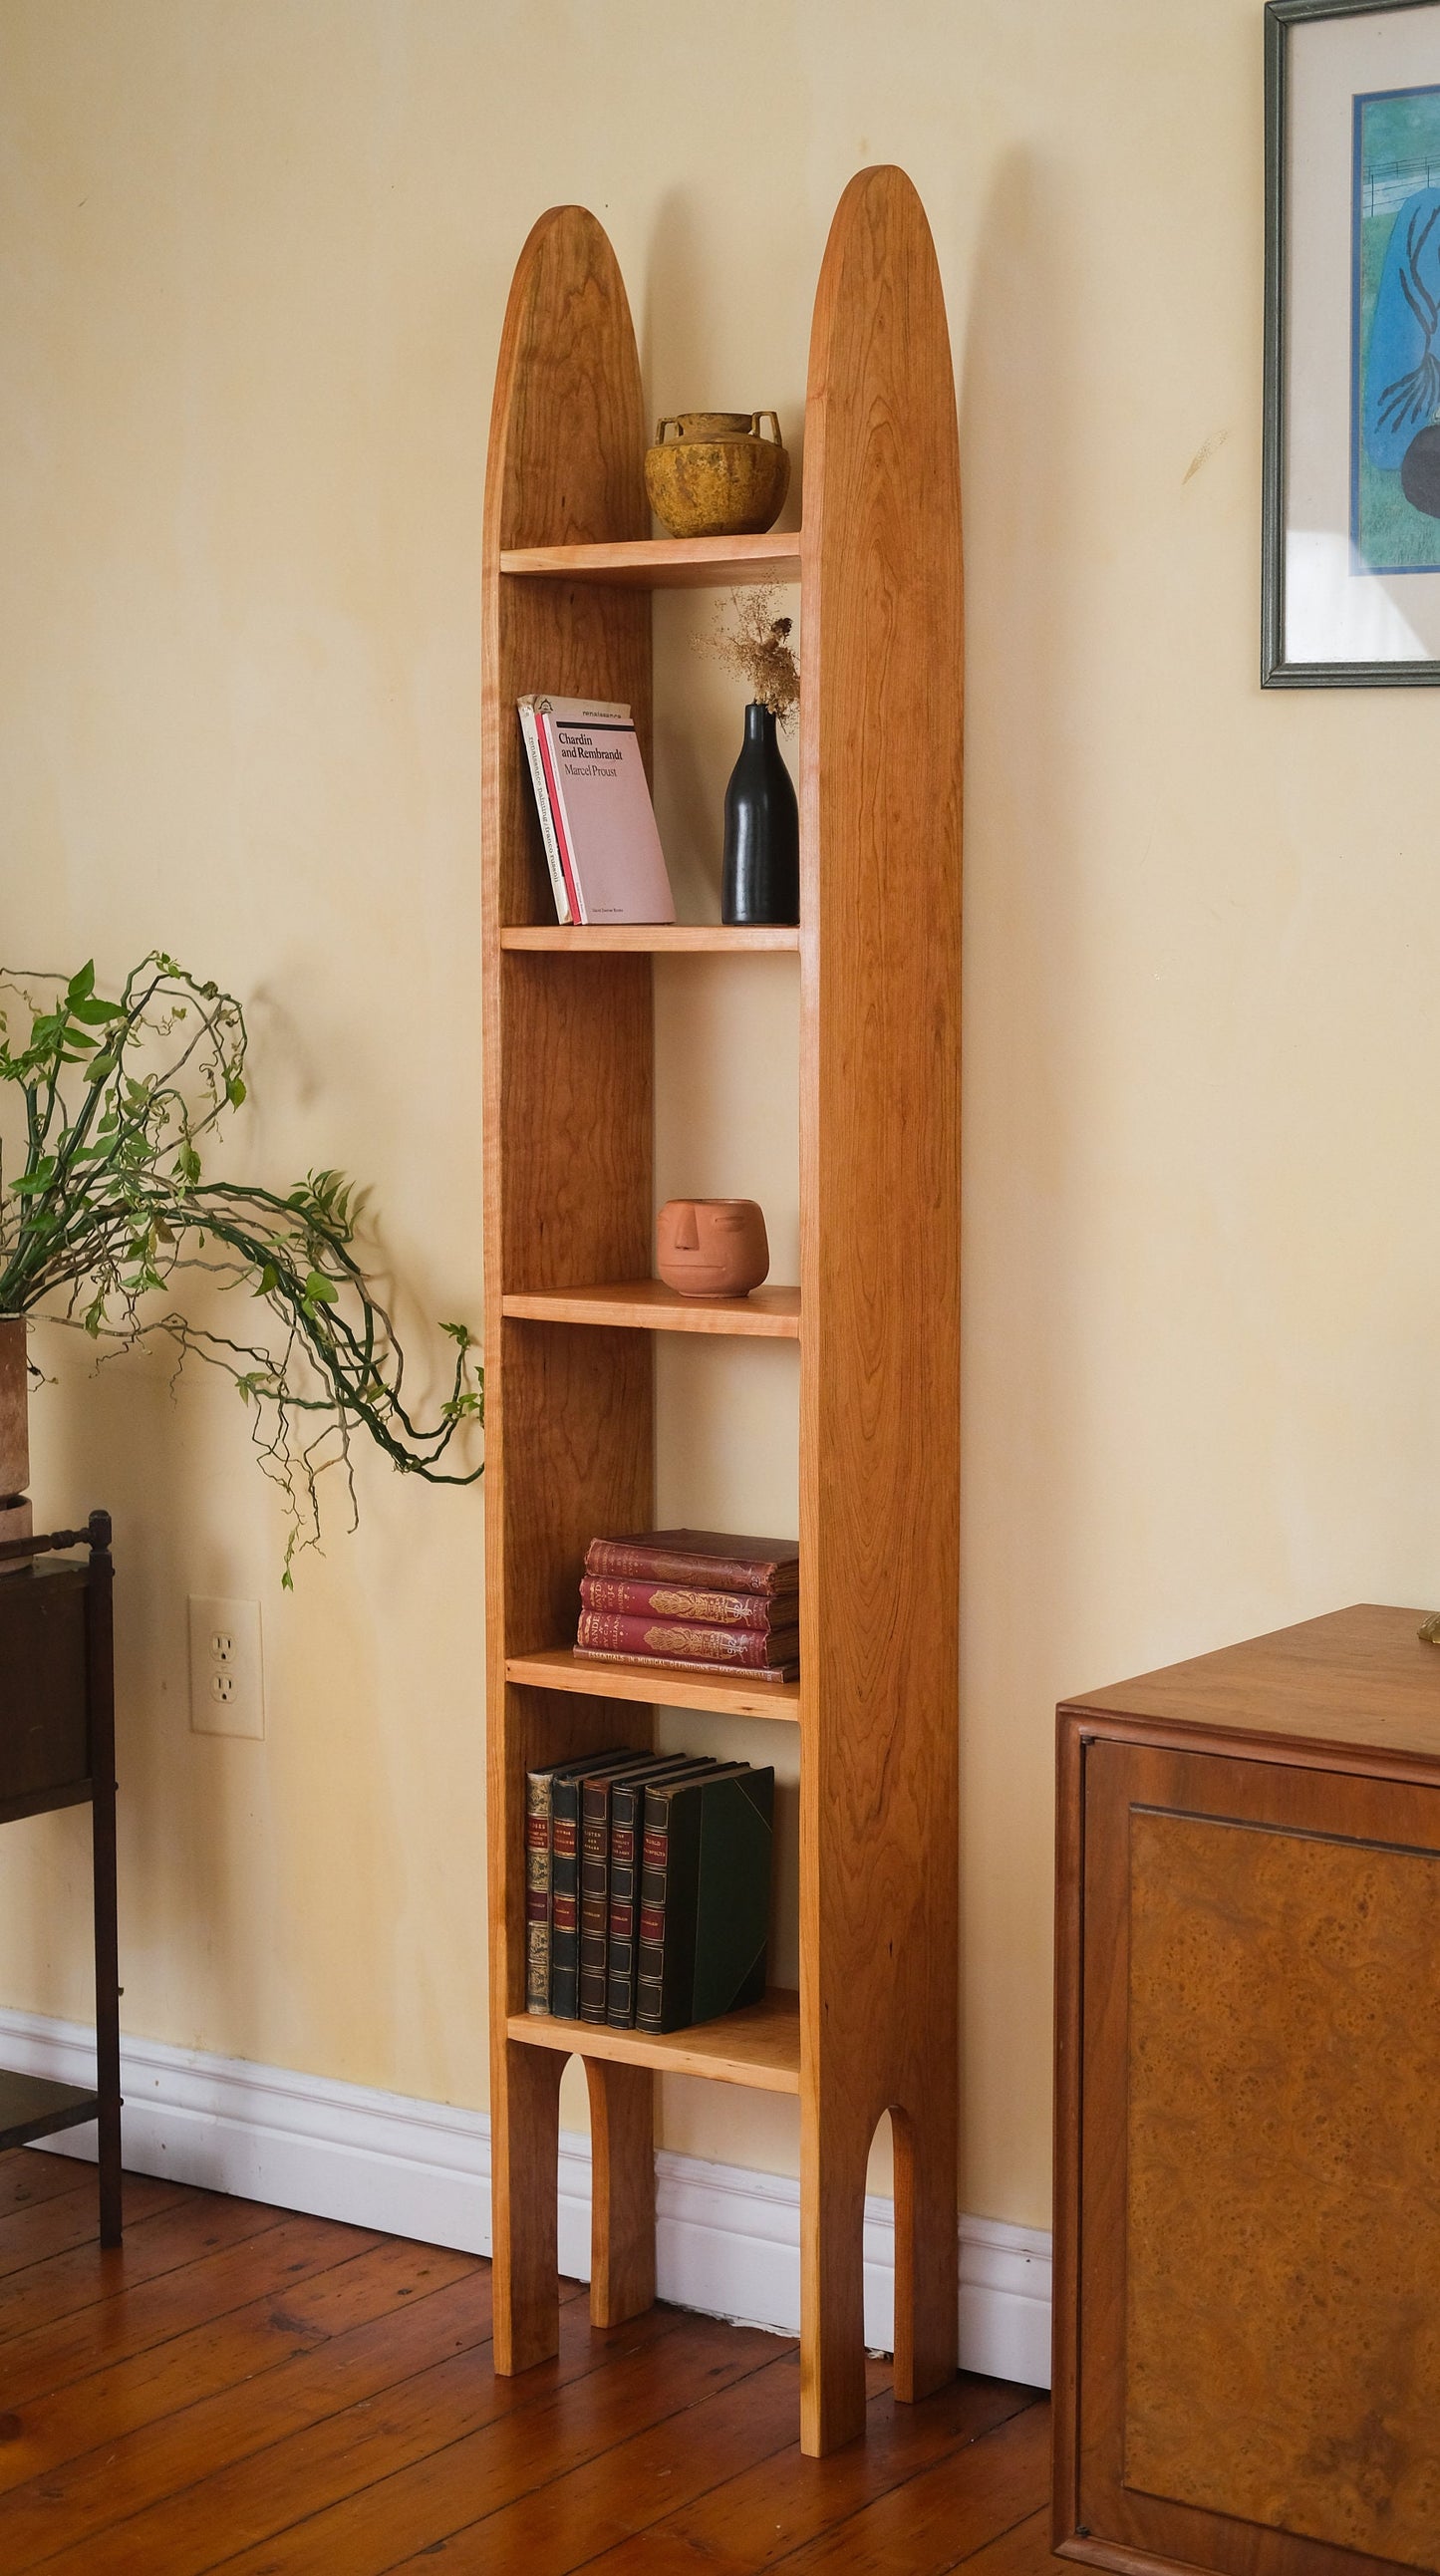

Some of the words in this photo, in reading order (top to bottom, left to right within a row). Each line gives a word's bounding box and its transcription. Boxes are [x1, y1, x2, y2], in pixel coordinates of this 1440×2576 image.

[558, 732, 593, 745] Chardin
[561, 747, 577, 758] and
[578, 746, 623, 760] Rembrandt
[564, 763, 591, 776] Marcel
[591, 765, 618, 777] Proust
[589, 1651, 625, 1662] ESSENTIALS
[637, 1657, 668, 1667] MUSICAL
